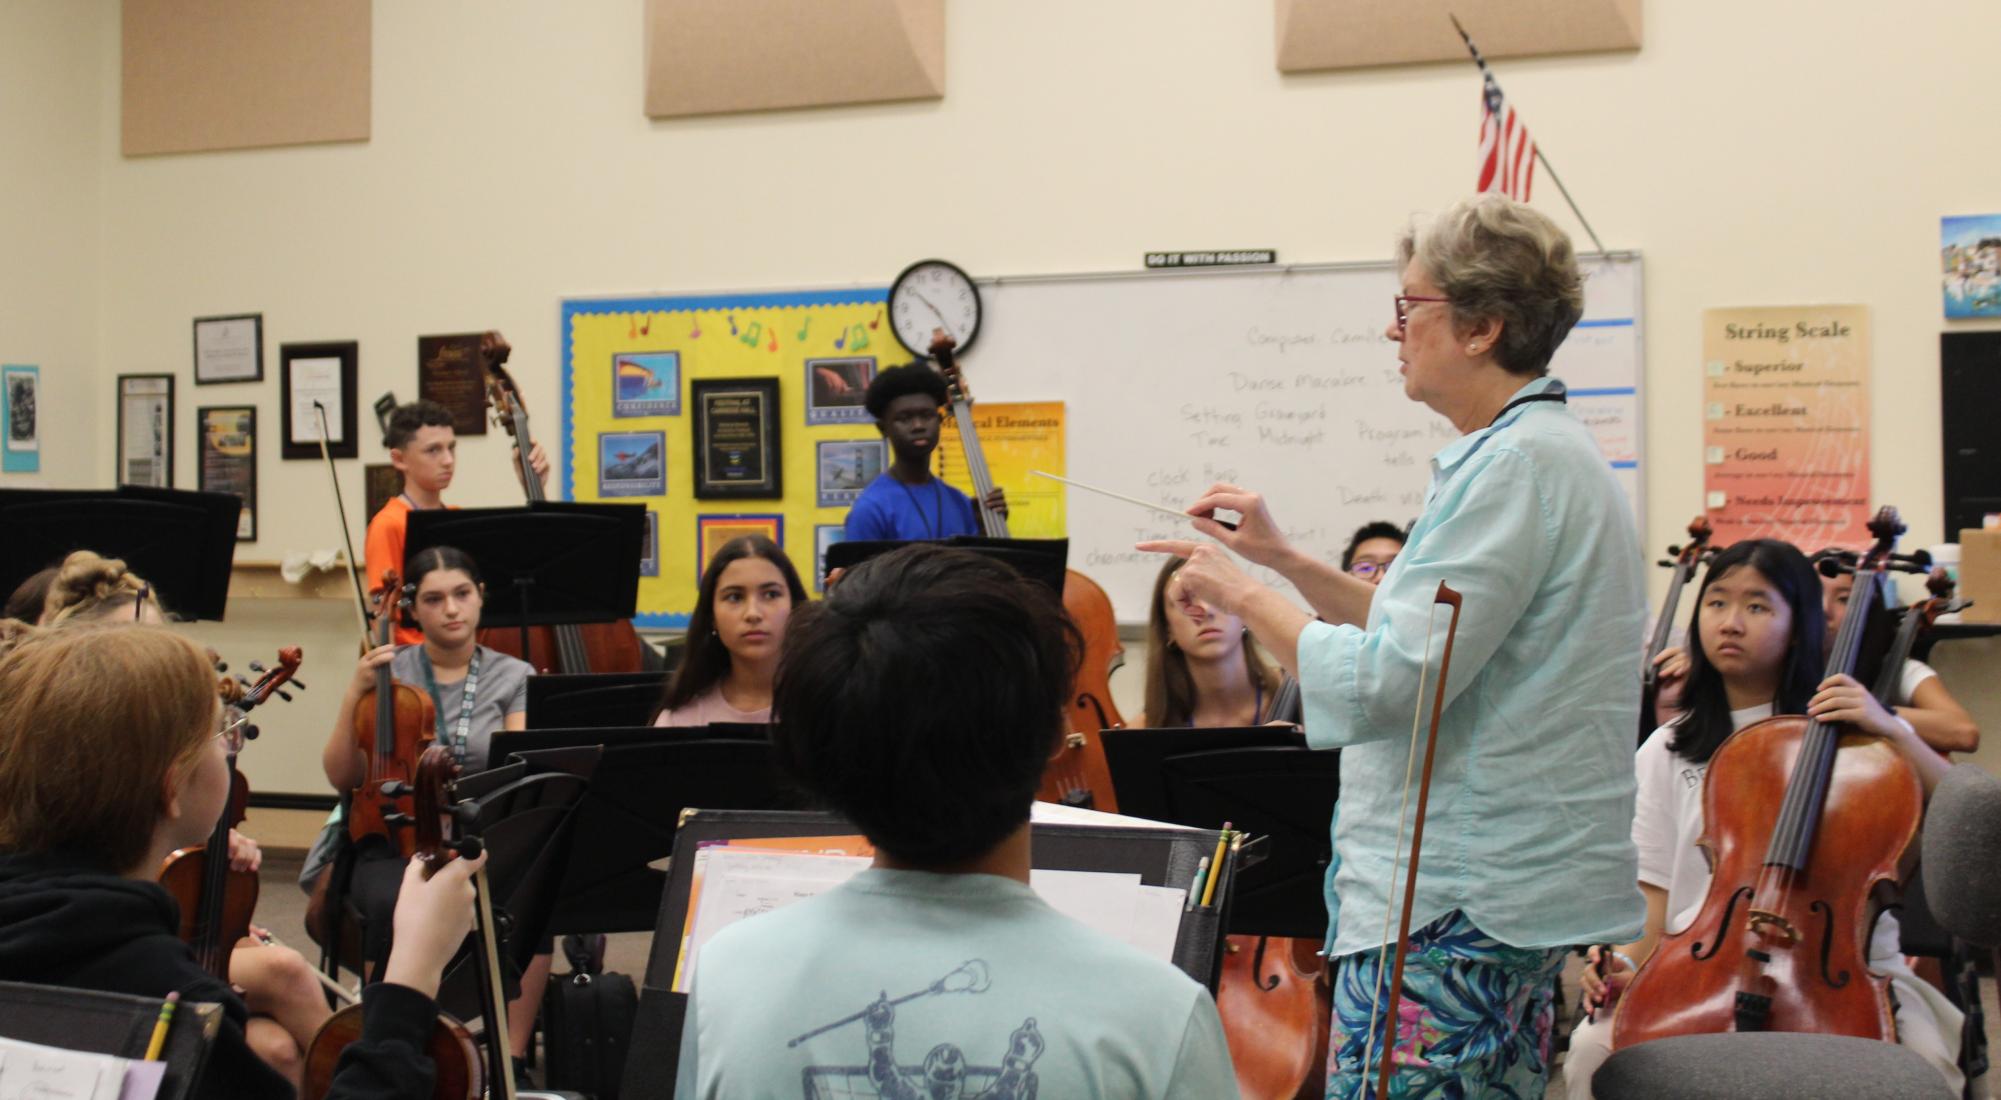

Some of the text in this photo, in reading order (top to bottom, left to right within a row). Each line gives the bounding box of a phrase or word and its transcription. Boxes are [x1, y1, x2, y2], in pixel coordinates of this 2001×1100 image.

[1147, 251, 1271, 265] DO IT WITH PASSION
[1724, 320, 1852, 344] String Scale
[1734, 360, 1804, 377] Superior
[1230, 371, 1285, 392] Danse
[1295, 368, 1366, 389] Macabre
[1735, 403, 1808, 417] Excellent
[996, 415, 1060, 429] Elements
[1734, 447, 1778, 462] Good
[1735, 495, 1775, 506] Needs
[1778, 495, 1867, 509] Improvement
